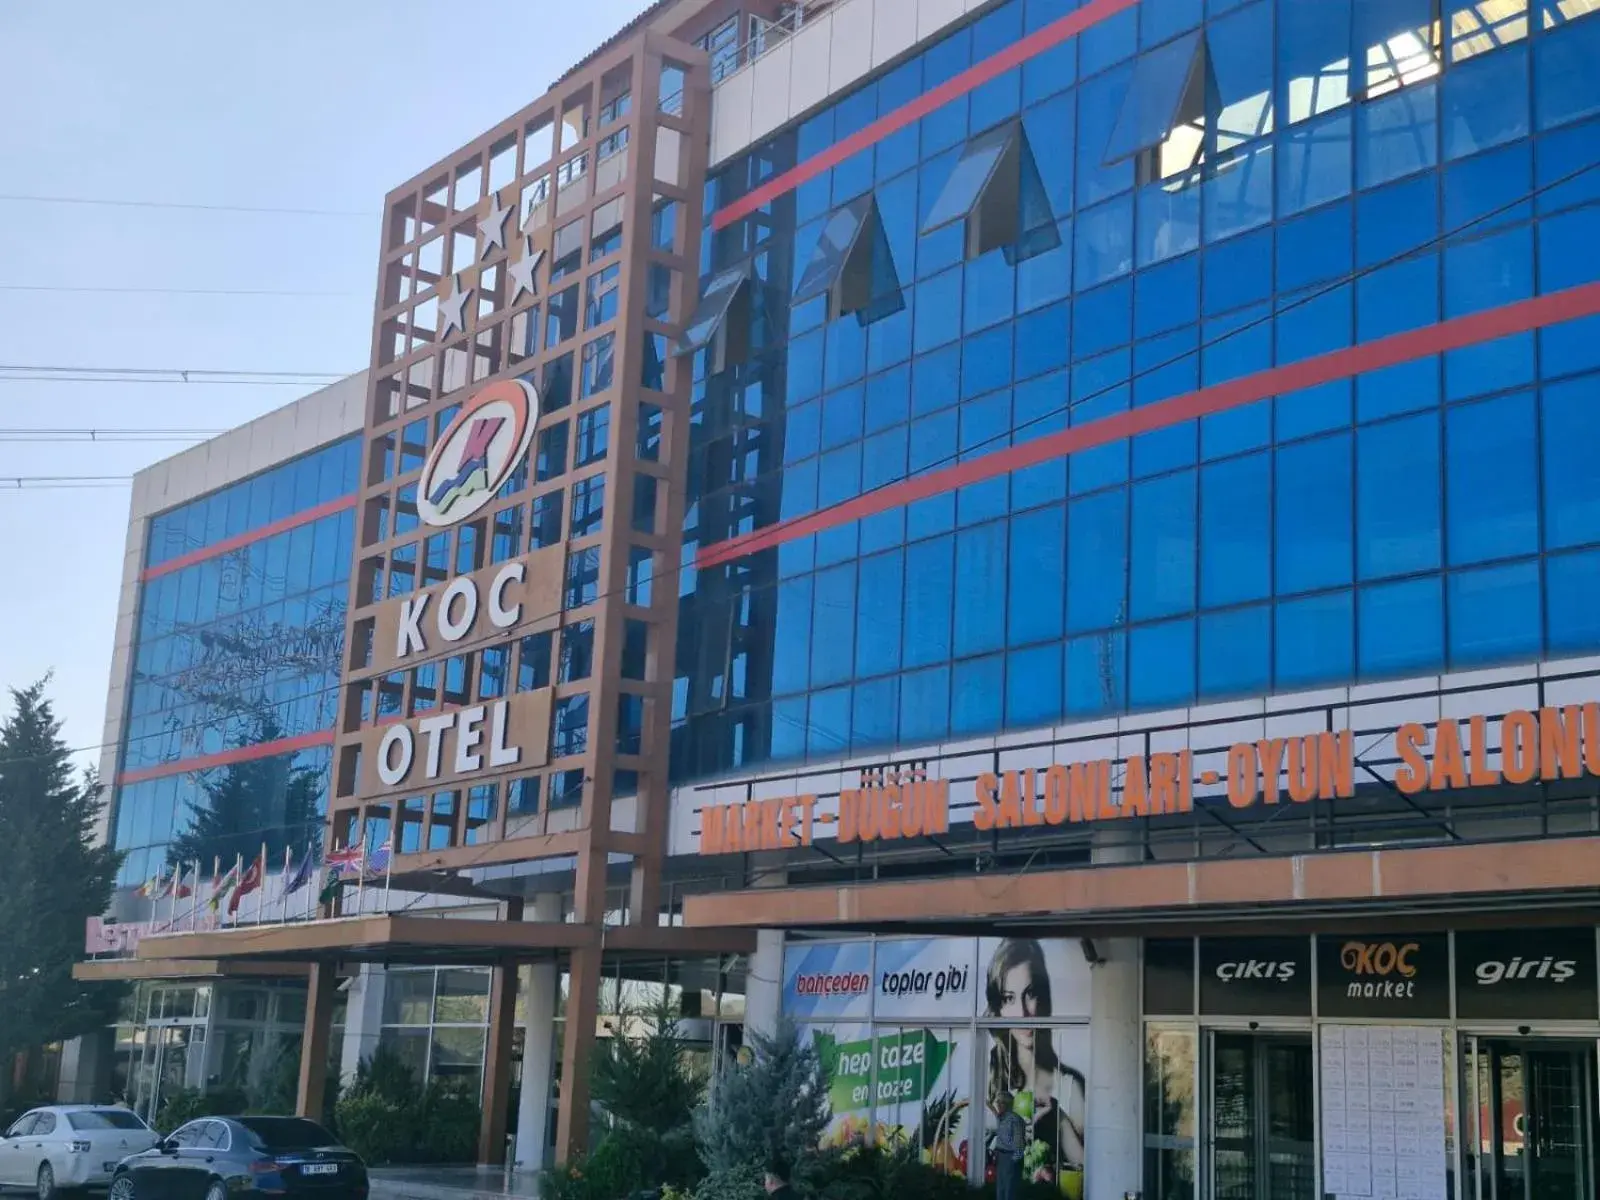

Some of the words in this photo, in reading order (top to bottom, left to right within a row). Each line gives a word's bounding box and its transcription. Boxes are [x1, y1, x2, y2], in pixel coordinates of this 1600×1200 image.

[377, 699, 521, 786] OTEL
[796, 972, 870, 997] bahçeden
[882, 967, 933, 998] toplar
[936, 964, 968, 999] gibi
[1475, 956, 1577, 985] giriş
[1346, 980, 1415, 998] market
[837, 1051, 872, 1076] hep
[880, 1042, 925, 1069] taze
[852, 1085, 869, 1103] en
